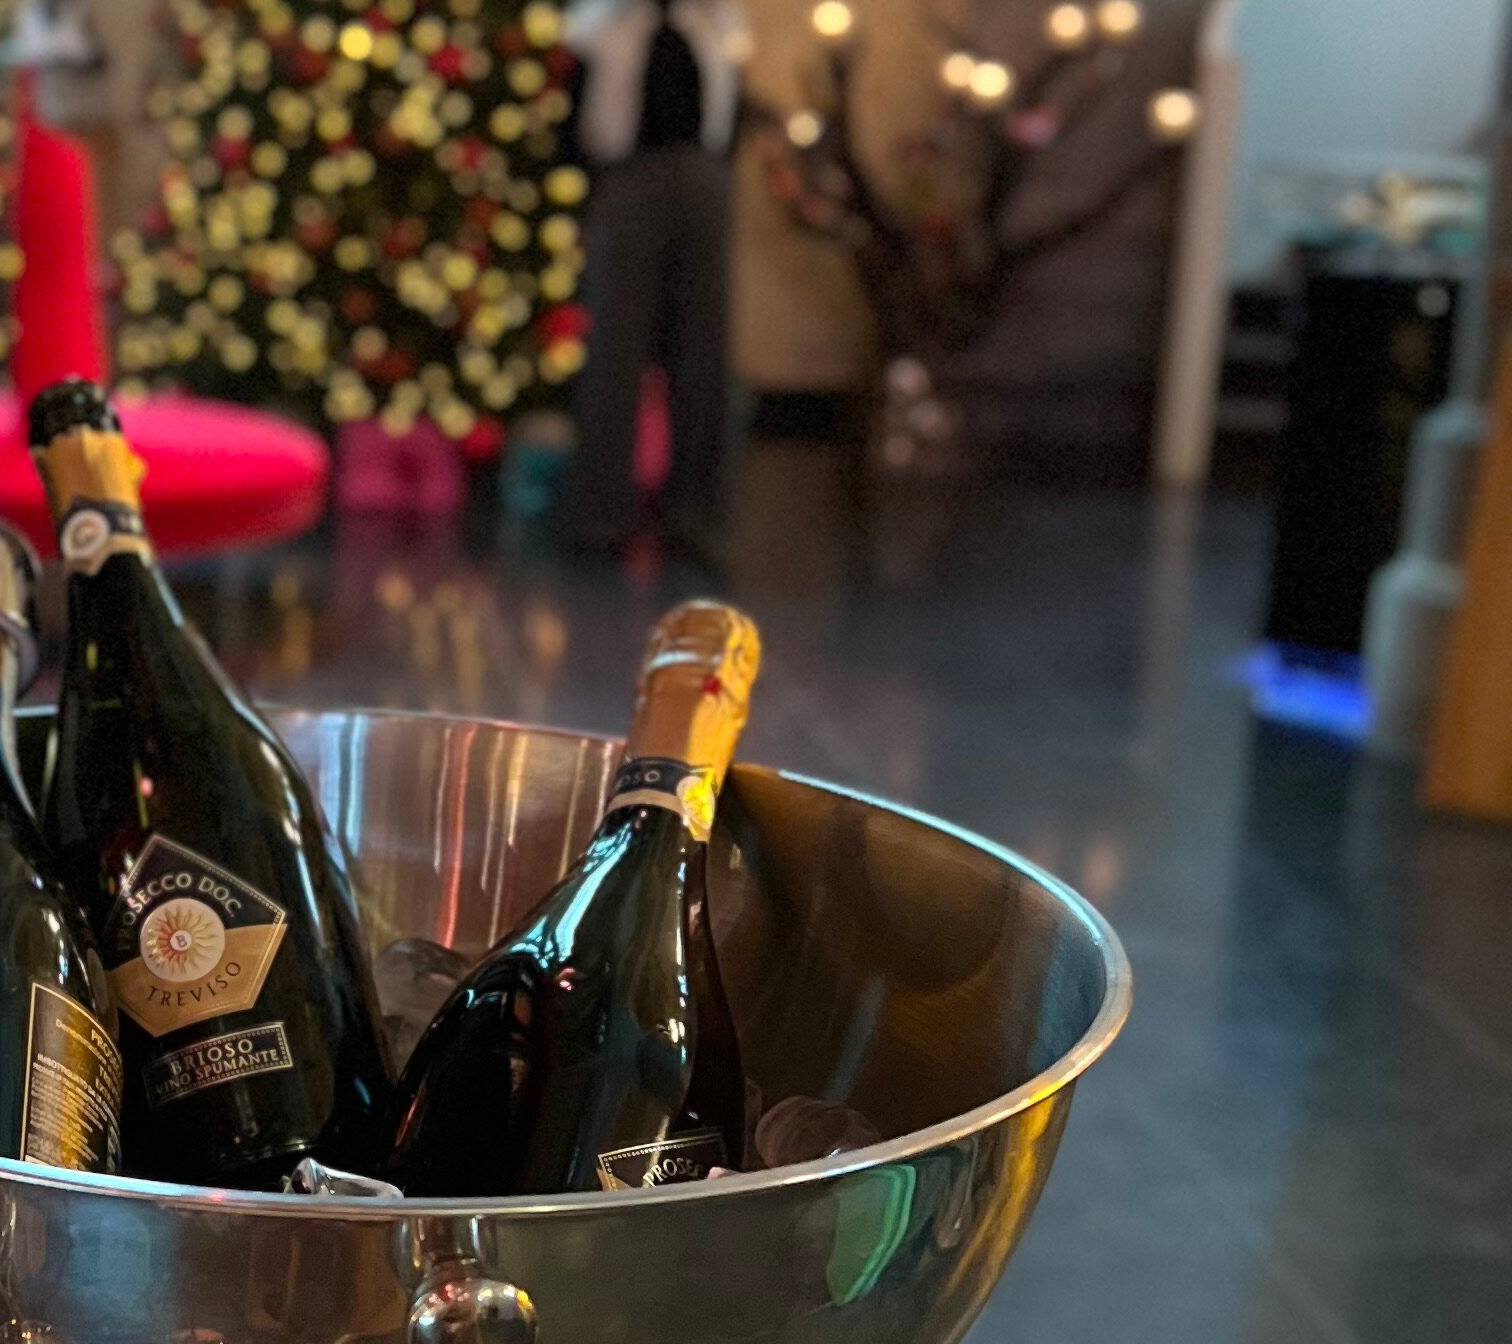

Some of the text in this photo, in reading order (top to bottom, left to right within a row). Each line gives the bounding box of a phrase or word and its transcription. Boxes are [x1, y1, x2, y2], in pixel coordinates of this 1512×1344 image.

[146, 961, 241, 1006] TREVISO
[169, 1038, 253, 1076] BRIOSO
[195, 1048, 279, 1081] SPUMANTE
